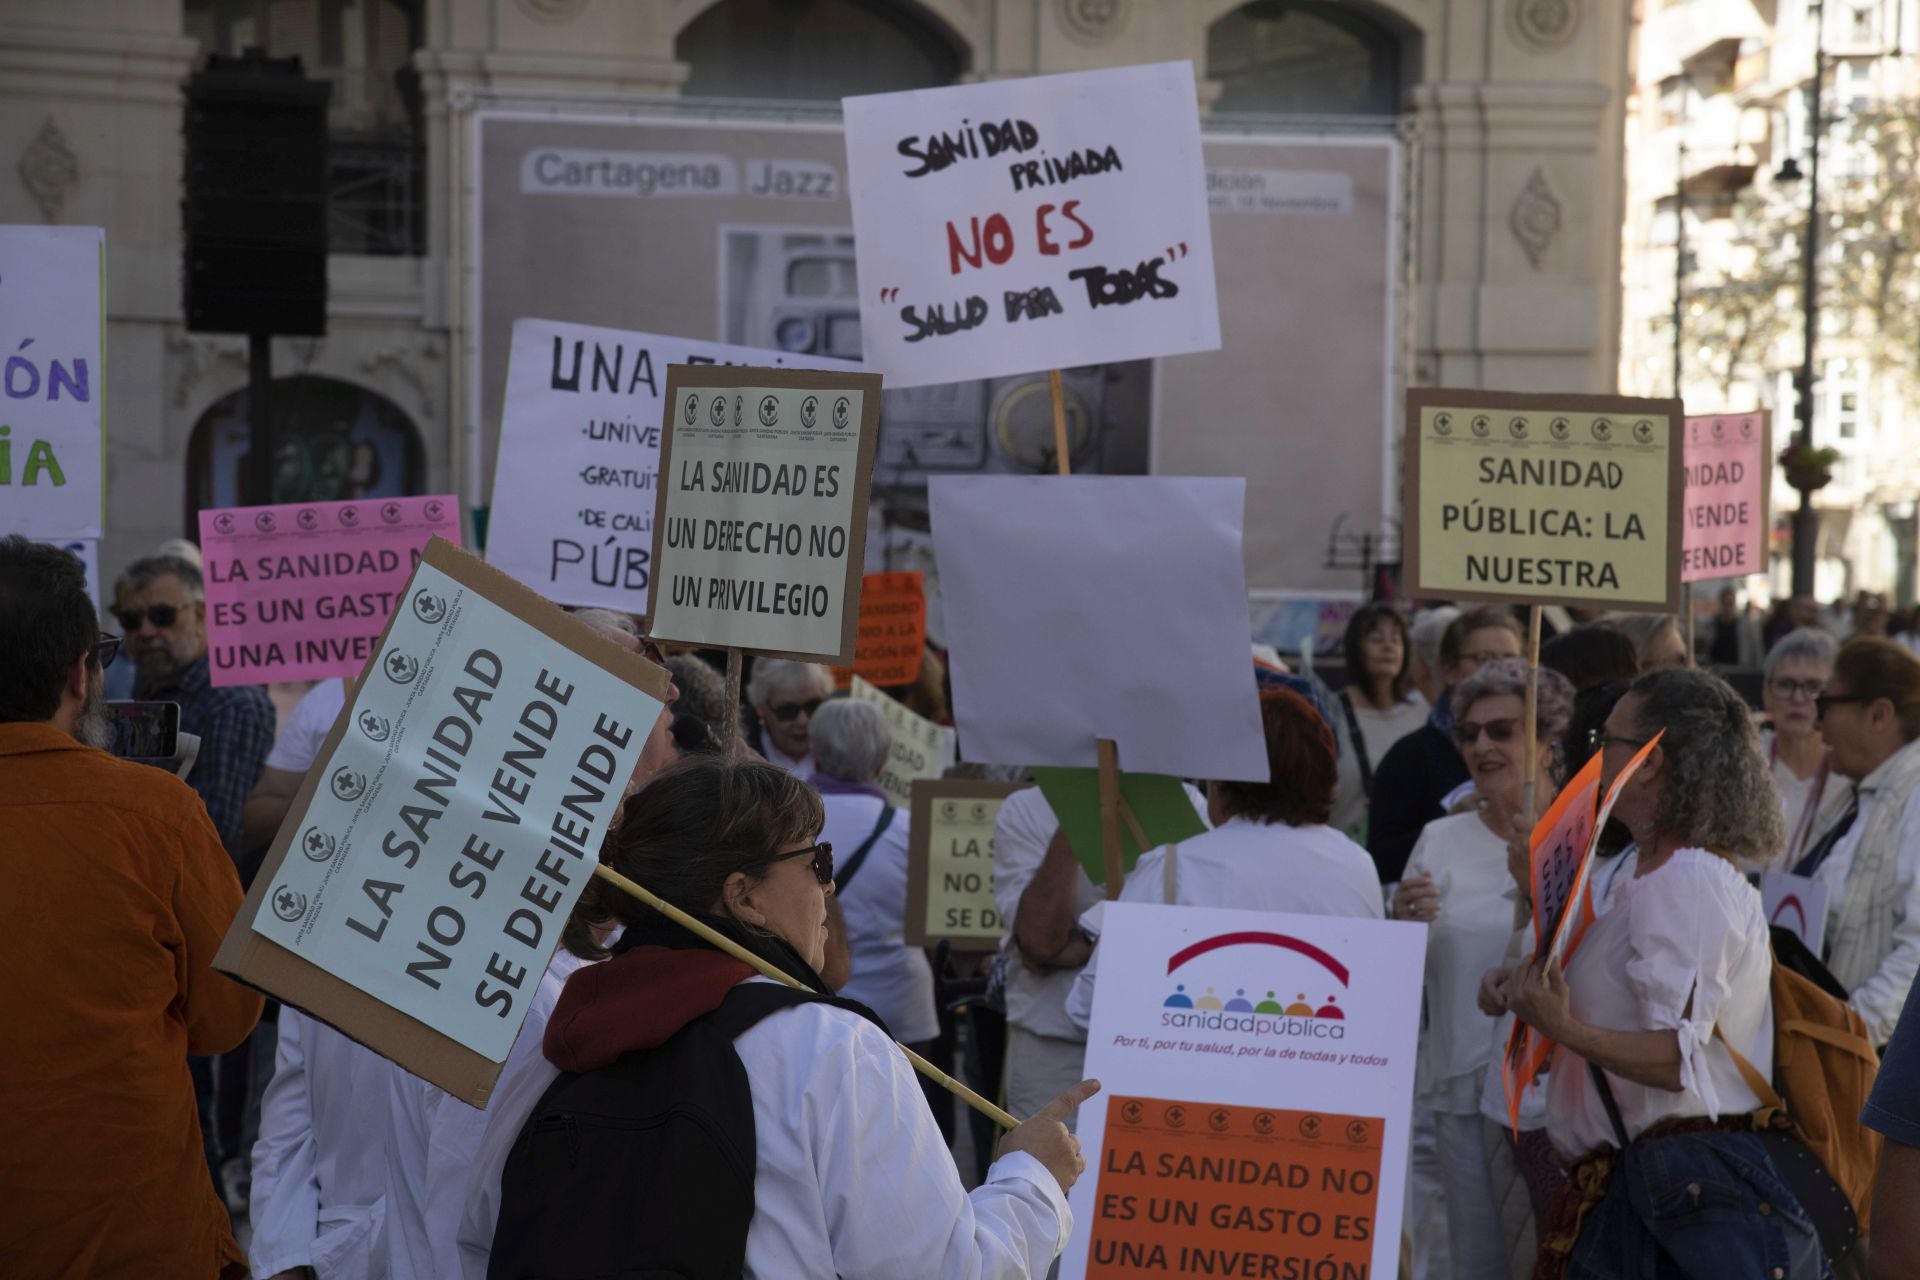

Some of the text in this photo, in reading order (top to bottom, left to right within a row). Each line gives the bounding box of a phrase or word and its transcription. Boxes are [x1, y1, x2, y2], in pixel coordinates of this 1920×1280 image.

[534, 153, 835, 198] Cartagena Jazz
[946, 200, 1094, 275] NO ES
[551, 336, 658, 398] UNA
[681, 460, 840, 498] LA SANIDAD ES
[1478, 456, 1623, 490] SANIDAD
[585, 508, 606, 528] DE
[667, 517, 846, 559] UN DERECHO NO
[1442, 498, 1646, 541] PÚBLICA: LA
[210, 559, 249, 584] LA
[257, 549, 399, 581] SANIDAD
[550, 535, 650, 591] PÚB
[1466, 554, 1621, 590] NUESTRA
[213, 601, 248, 626] ES
[257, 597, 304, 623] UN
[672, 574, 829, 618] UN PRIVILEGIO
[215, 642, 286, 670] UNA
[345, 648, 503, 943] LA SANIDAD
[405, 669, 575, 991] NO SE VENDE
[952, 838, 981, 858] LA
[474, 712, 634, 1019] SE DEFIENDE
[944, 873, 981, 894] NO
[946, 908, 972, 928] SE
[1161, 1011, 1345, 1039] sanidadpública
[1113, 1035, 1136, 1047] Por
[1152, 1040, 1177, 1052] por
[1179, 1040, 1193, 1052] tu
[1195, 1042, 1235, 1056] salud,
[1237, 1046, 1262, 1057] por
[1264, 1046, 1276, 1058] la
[1280, 1048, 1296, 1060] de
[1299, 1049, 1337, 1063] todas
[1338, 1055, 1348, 1066] y
[1350, 1054, 1389, 1067] todos
[1106, 1149, 1374, 1195] LA SANIDAD NO
[1101, 1193, 1370, 1241] ES UN GASTO ES
[1094, 1239, 1367, 1280] UNA INVERSIÓN
